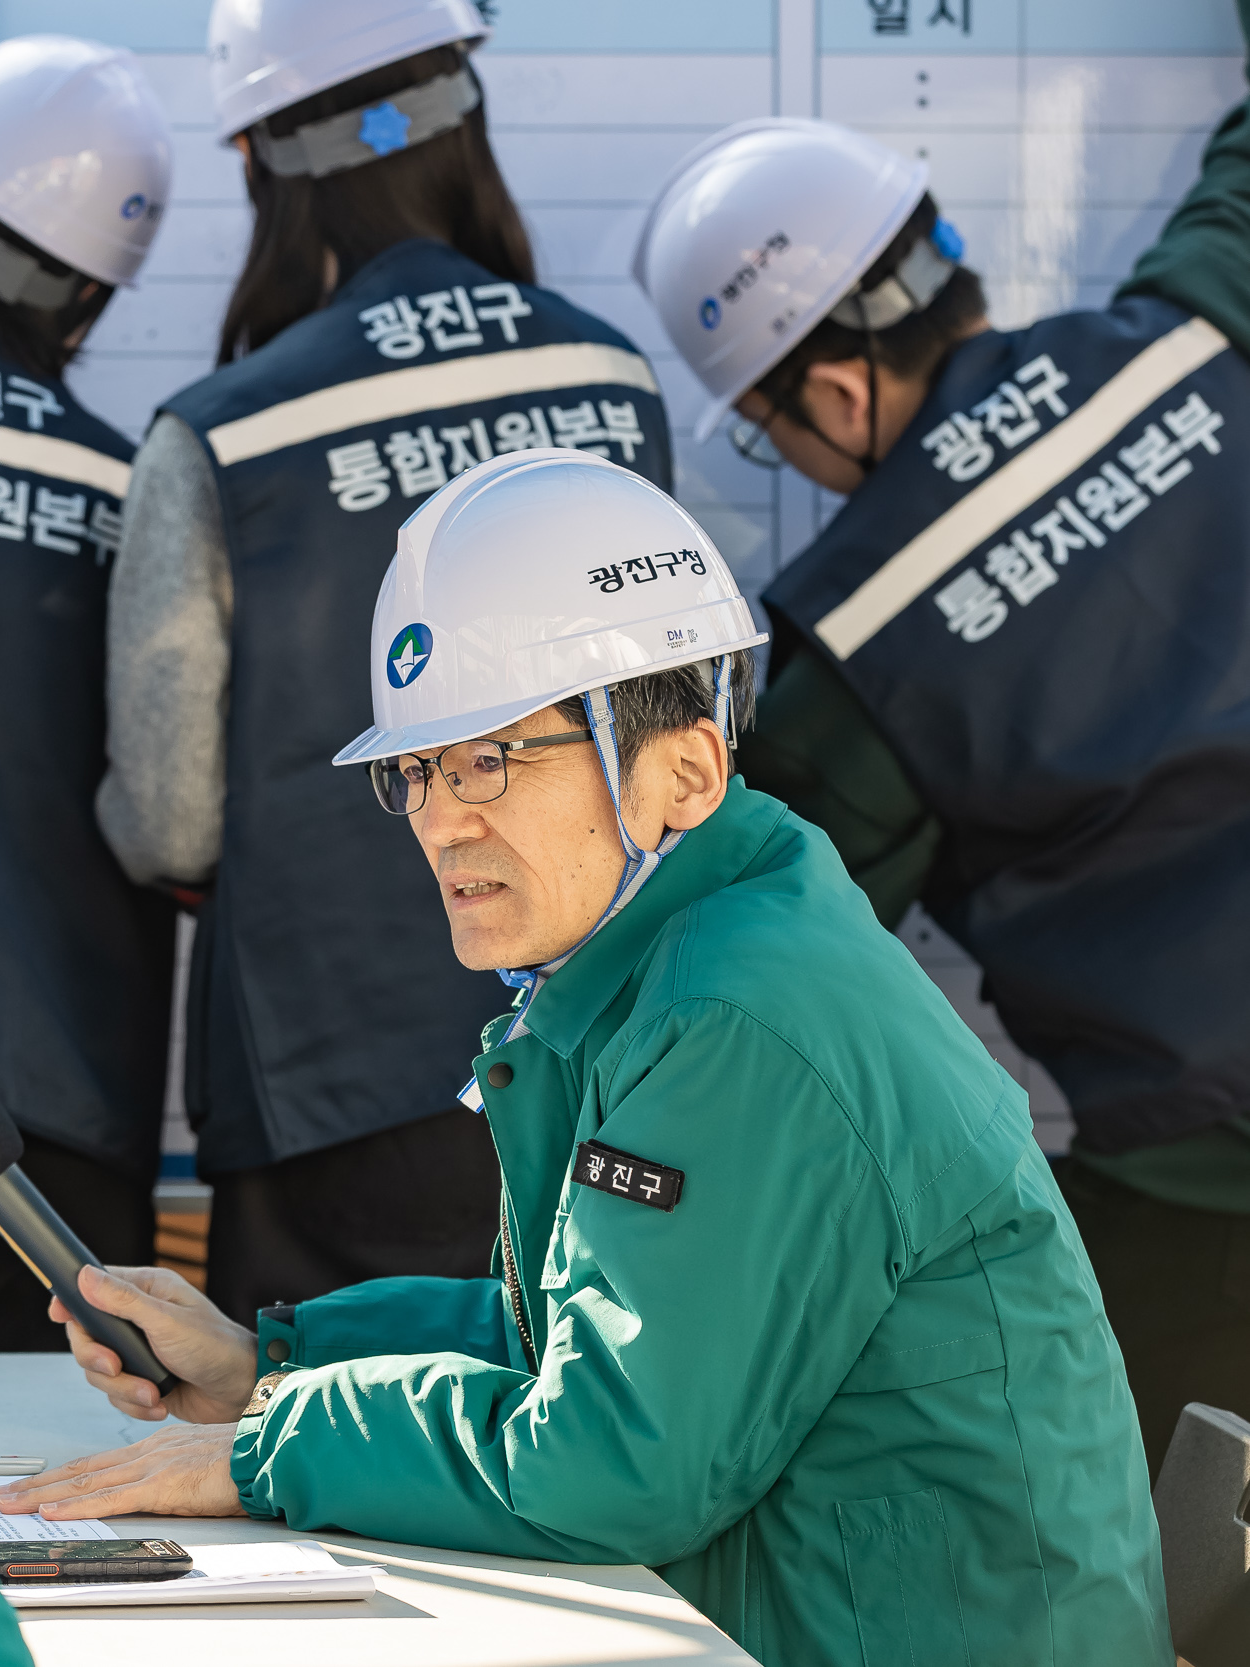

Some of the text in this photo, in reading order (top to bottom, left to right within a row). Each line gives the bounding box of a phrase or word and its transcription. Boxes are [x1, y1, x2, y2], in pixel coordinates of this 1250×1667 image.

[358, 282, 533, 359] 광진구
[921, 354, 1069, 482] 광진구
[934, 392, 1224, 643] 통합지원본부
[587, 549, 706, 593] 광진구청
[666, 629, 684, 641] DM
